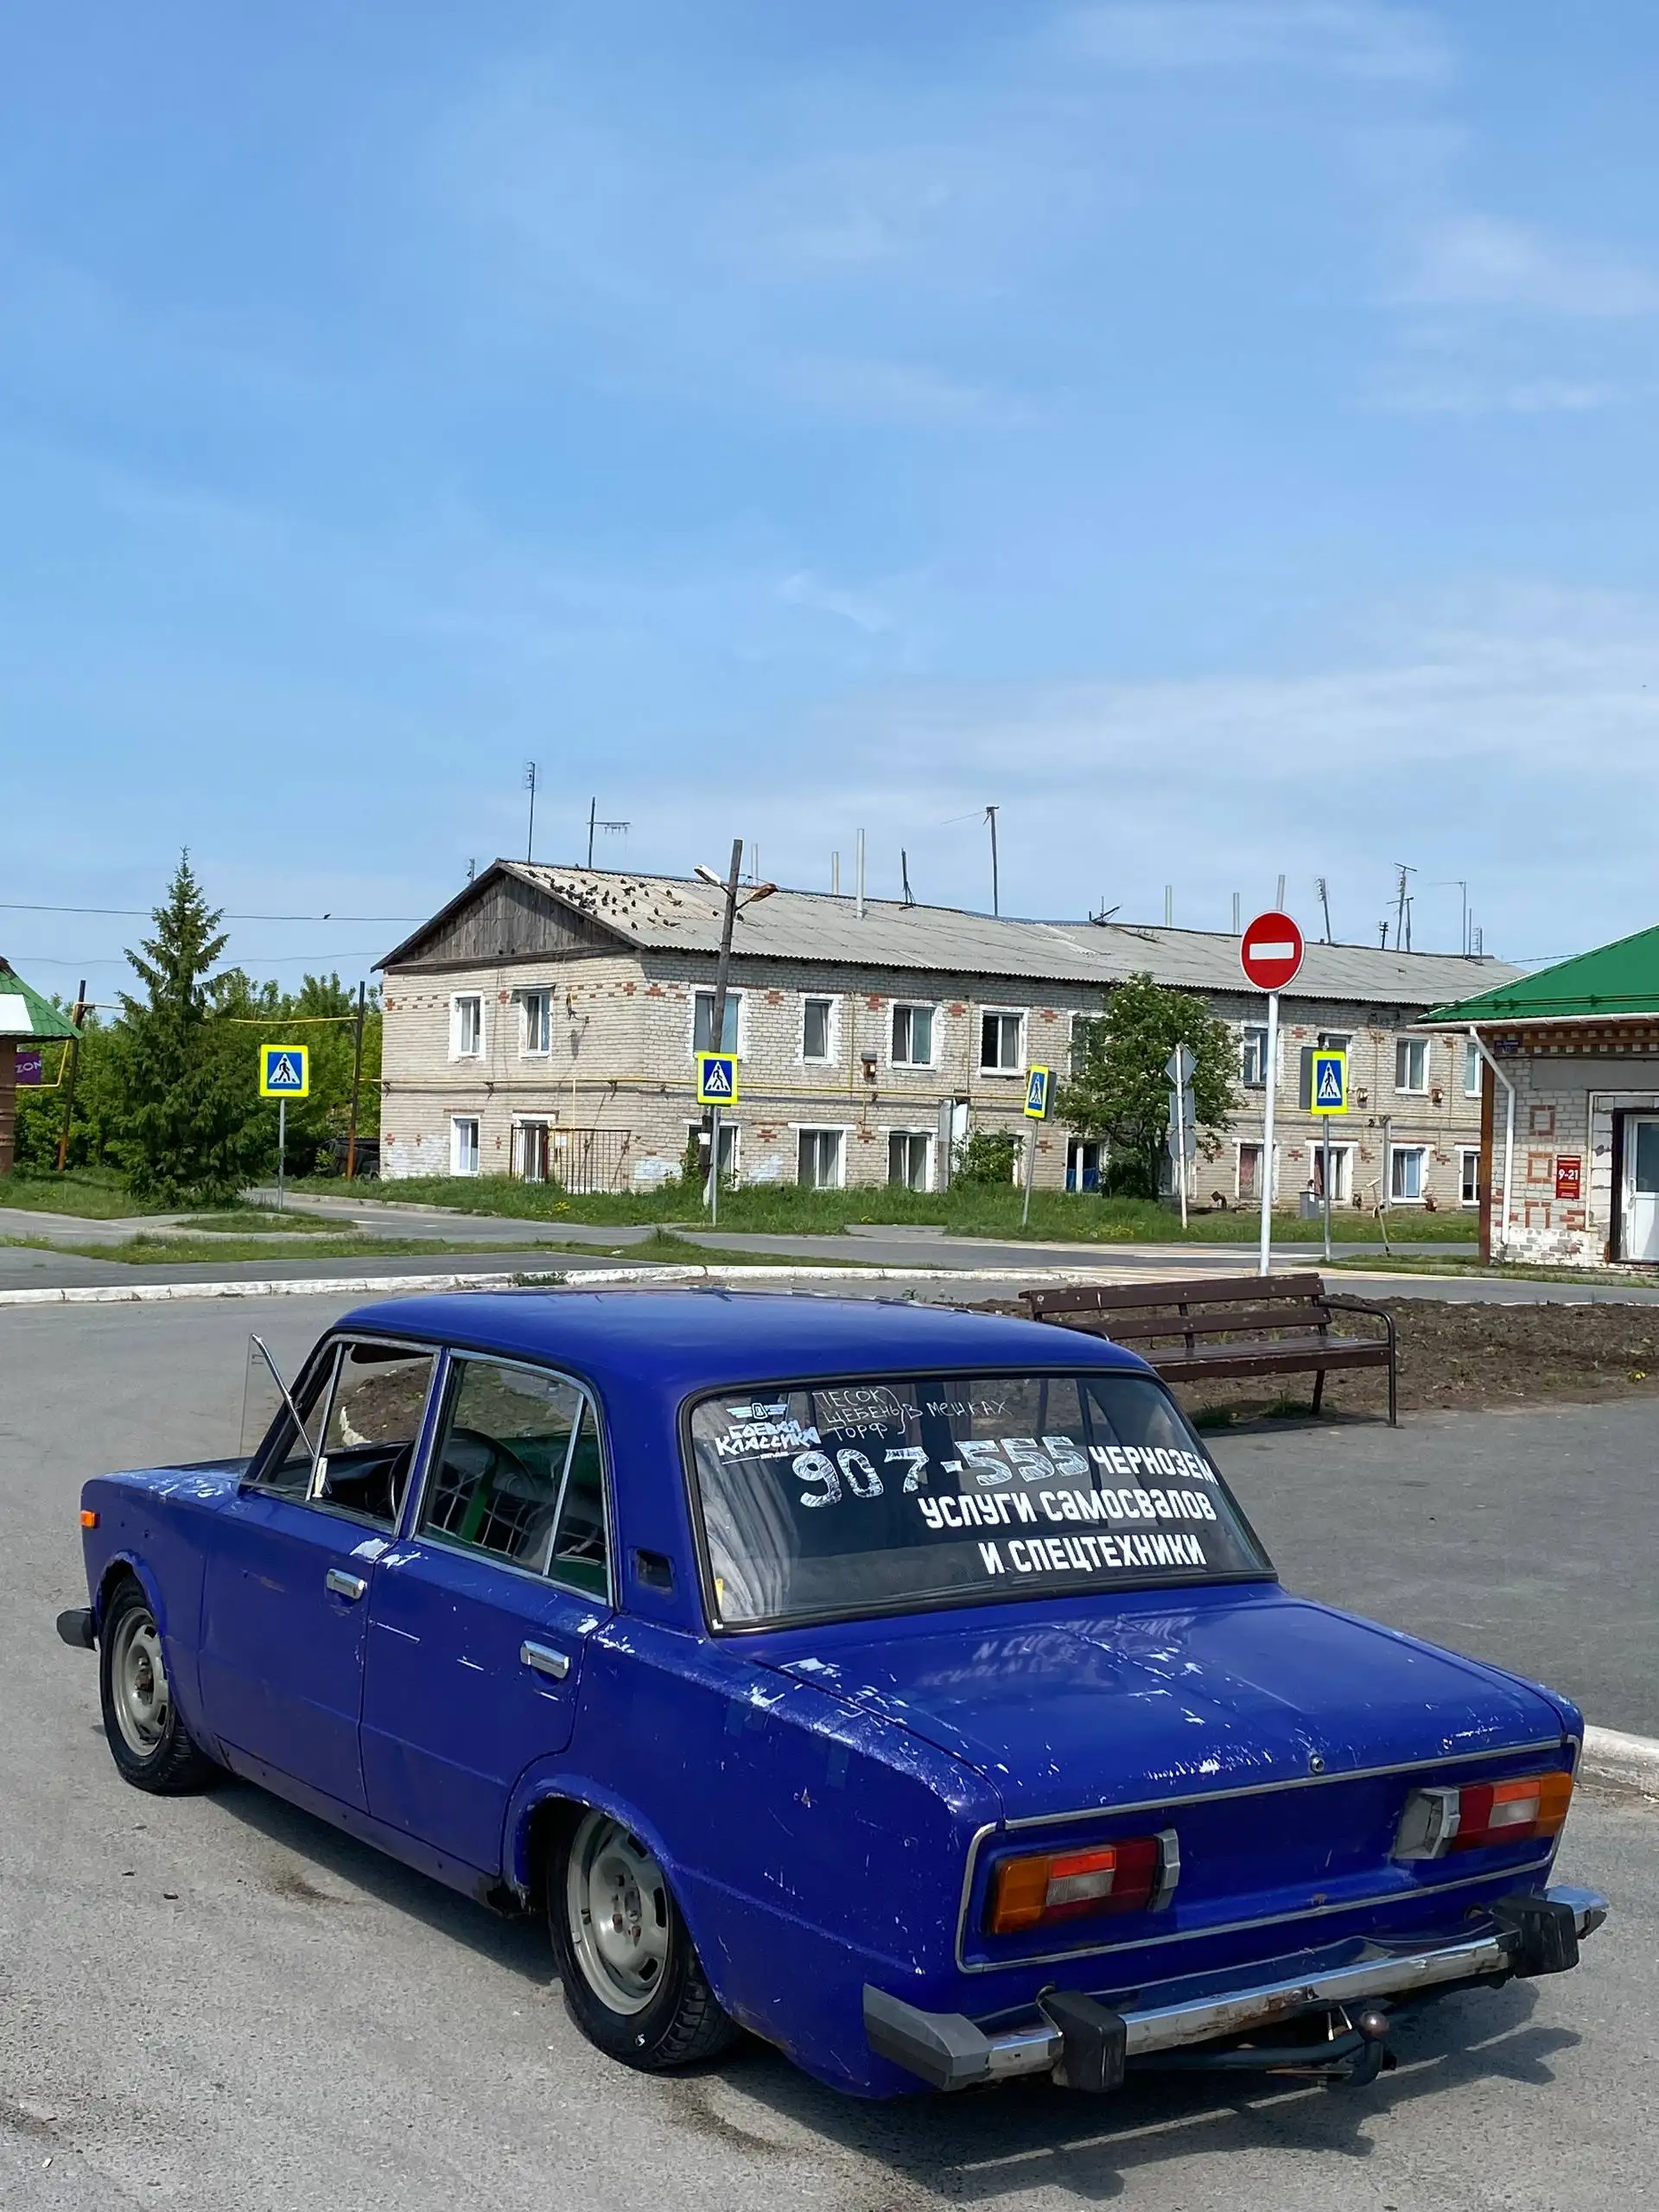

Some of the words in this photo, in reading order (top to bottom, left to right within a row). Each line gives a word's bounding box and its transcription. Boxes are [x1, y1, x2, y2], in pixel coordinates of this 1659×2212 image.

[15, 1060, 41, 1073] ZON
[1559, 1169, 1579, 1180] 9-21
[812, 1388, 887, 1409] ПЕСОК
[823, 1403, 900, 1427] ЩЕБЕНЬ
[714, 1426, 823, 1457] КЛАССИКА
[1088, 1446, 1219, 1486] ЧЕРНОЗЕМ
[918, 1491, 1038, 1529] УСЛУГИ
[977, 1541, 1006, 1575] И
[1007, 1534, 1207, 1572] СПЕЦТЕХНИКИ
